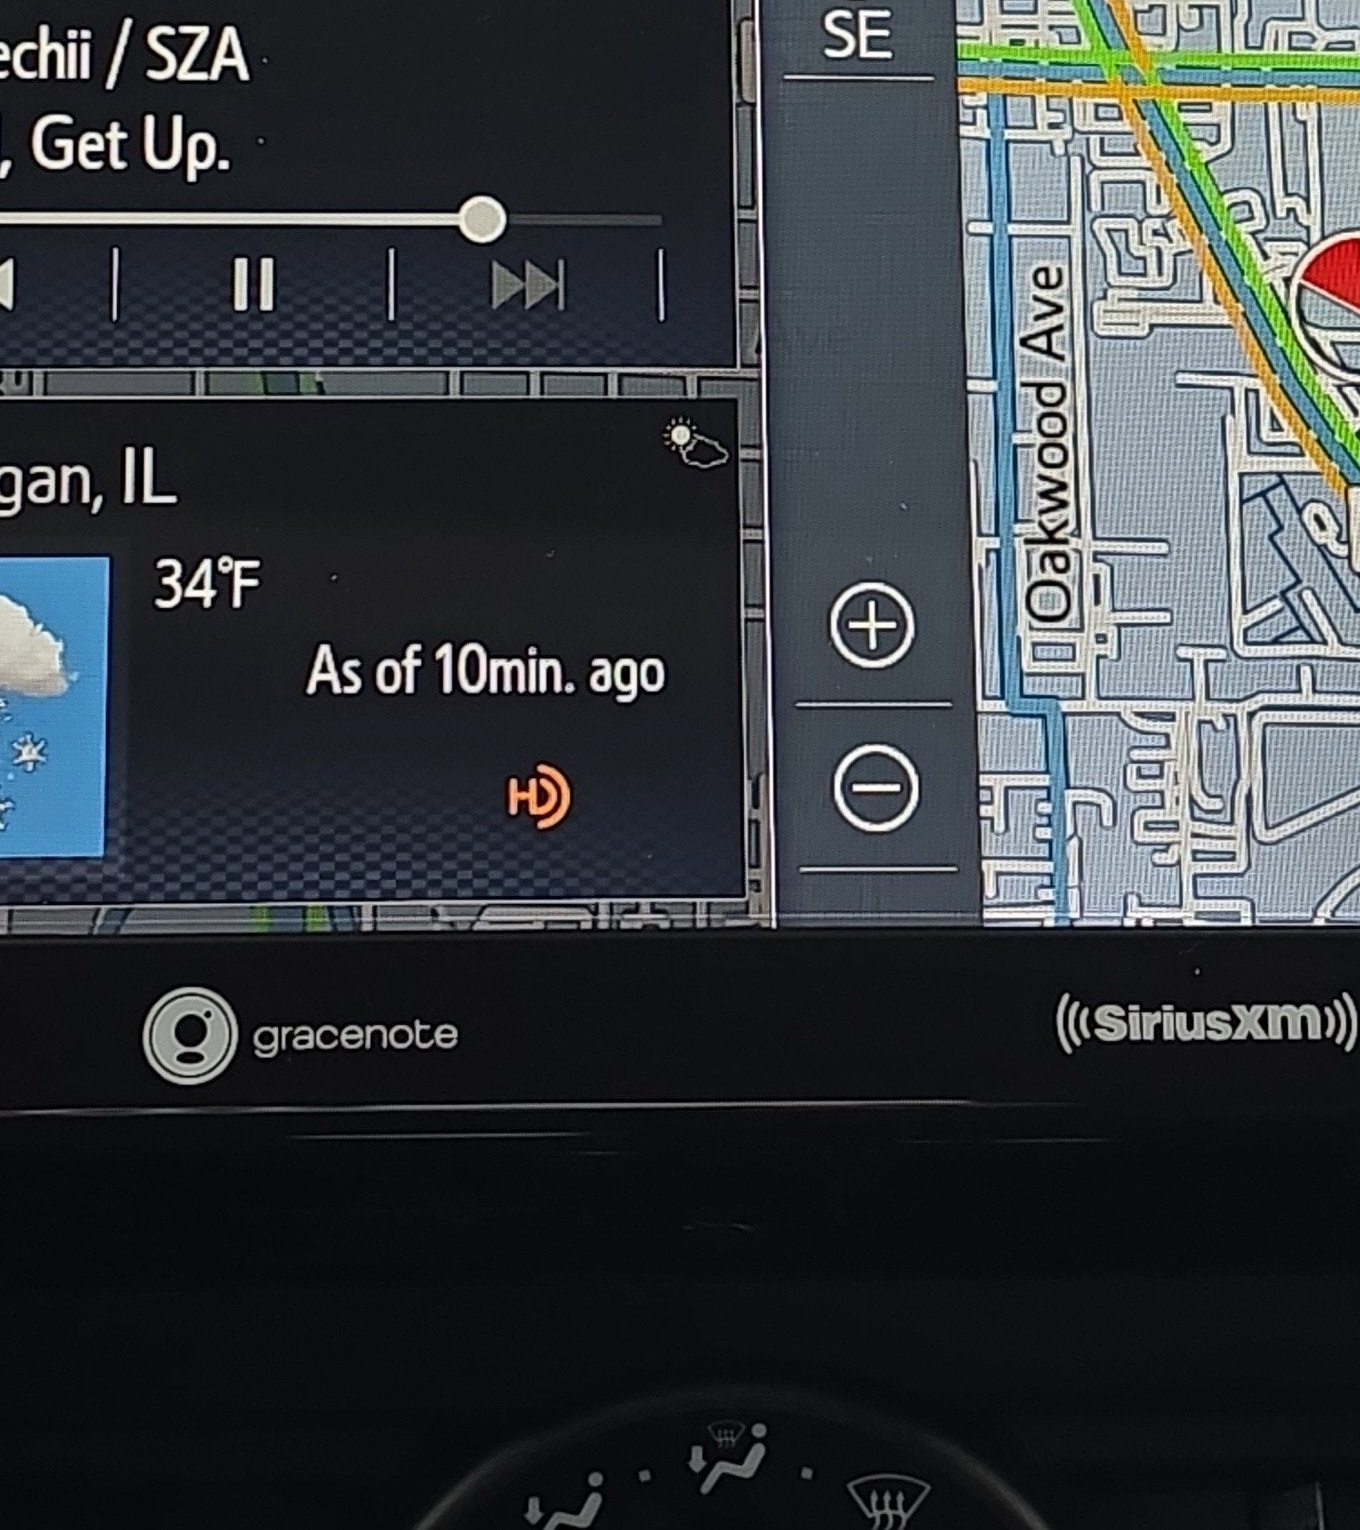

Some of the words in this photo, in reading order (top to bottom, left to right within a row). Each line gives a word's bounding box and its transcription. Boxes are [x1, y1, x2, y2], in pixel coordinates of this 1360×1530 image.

[105, 17, 133, 90] /
[146, 25, 250, 81] SZA
[824, 9, 893, 59] SE
[32, 114, 128, 170] Get
[144, 114, 230, 183] Up.
[1019, 266, 1066, 362] Ave
[123, 446, 178, 504] IL
[1023, 381, 1072, 623] Oakwood
[306, 643, 362, 695] As
[375, 643, 422, 694] of
[435, 642, 576, 694] 10min.
[589, 658, 665, 703] ago
[253, 1019, 459, 1059] gracenote
